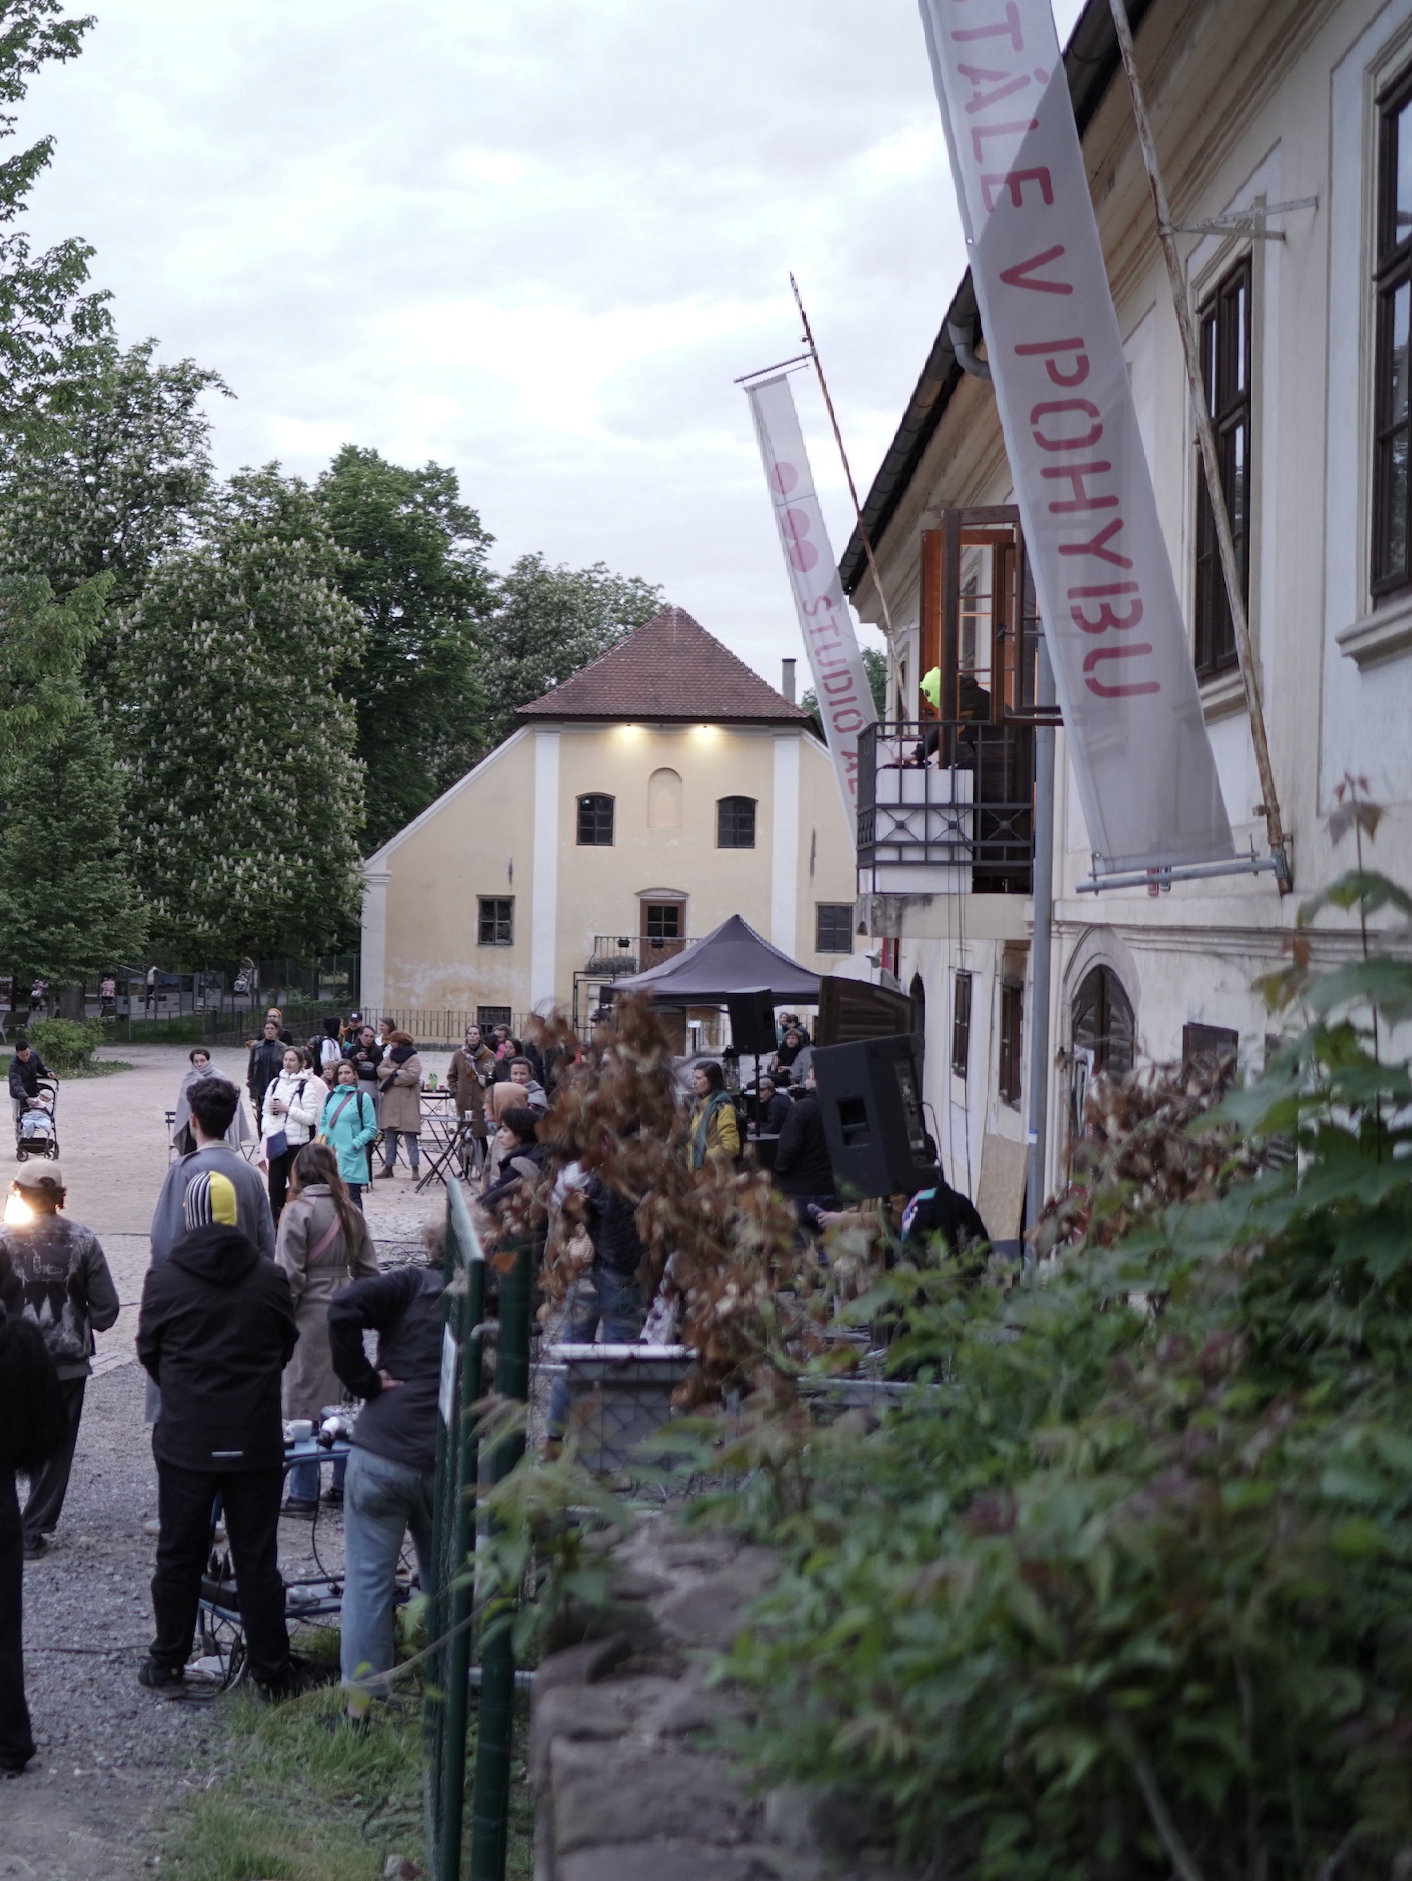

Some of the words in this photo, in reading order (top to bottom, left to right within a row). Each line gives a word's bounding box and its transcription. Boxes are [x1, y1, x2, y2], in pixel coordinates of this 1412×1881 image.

[950, 0, 1055, 214] TÁLE
[999, 244, 1074, 295] V
[1014, 337, 1161, 698] POHYBU
[802, 595, 864, 734] STUDIO
